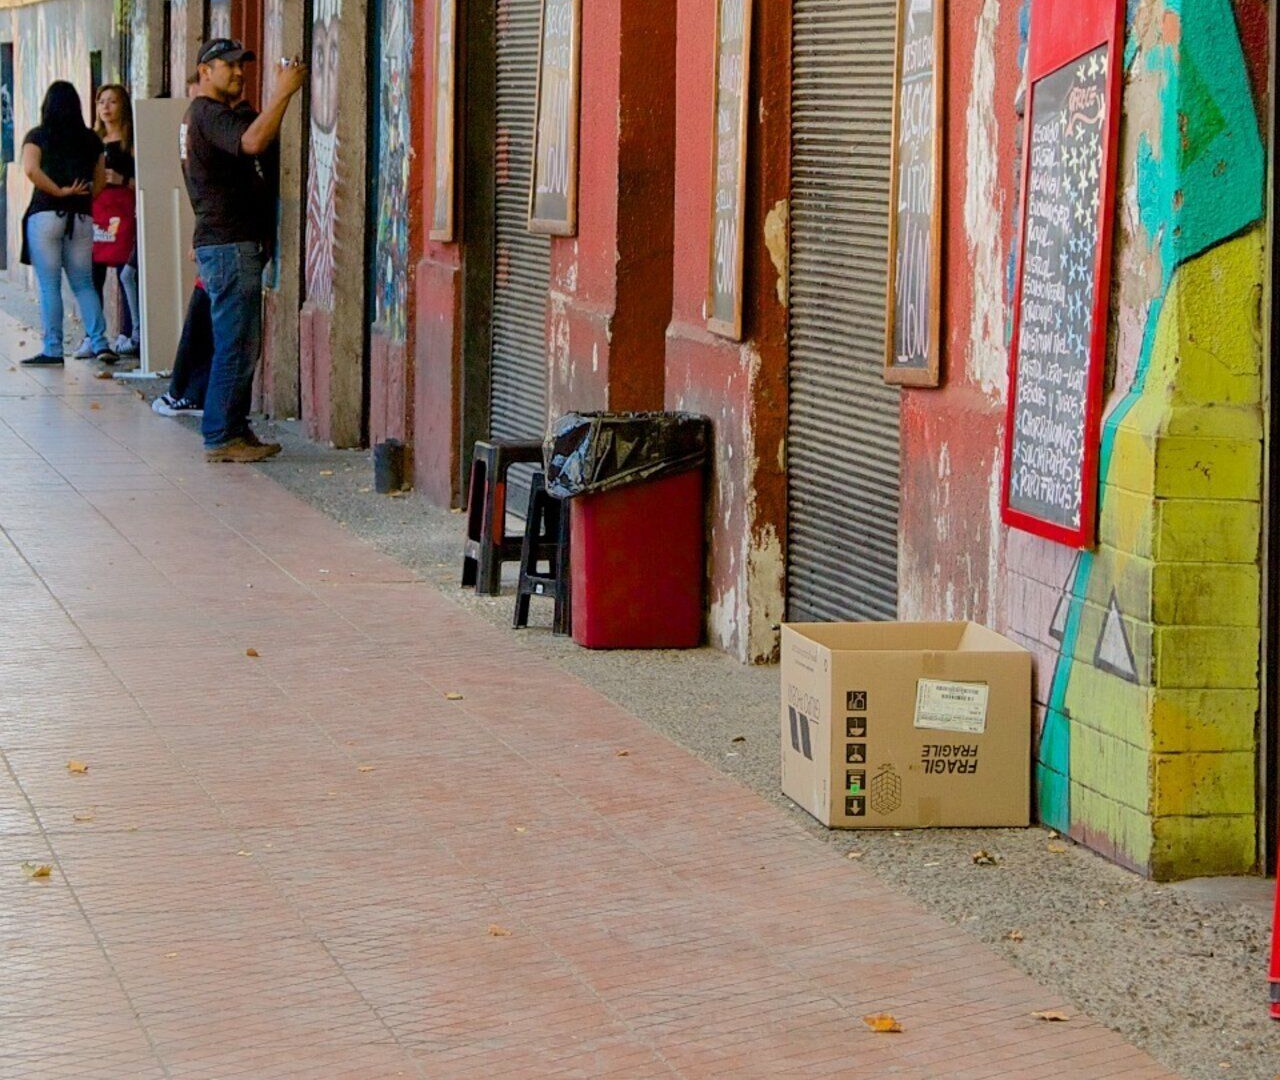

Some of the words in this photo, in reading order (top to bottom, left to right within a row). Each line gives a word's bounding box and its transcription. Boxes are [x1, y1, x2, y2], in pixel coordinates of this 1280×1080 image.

[899, 83, 933, 145] BECKE
[921, 745, 978, 758] FRAGILE
[922, 759, 978, 775] FRAGIL
